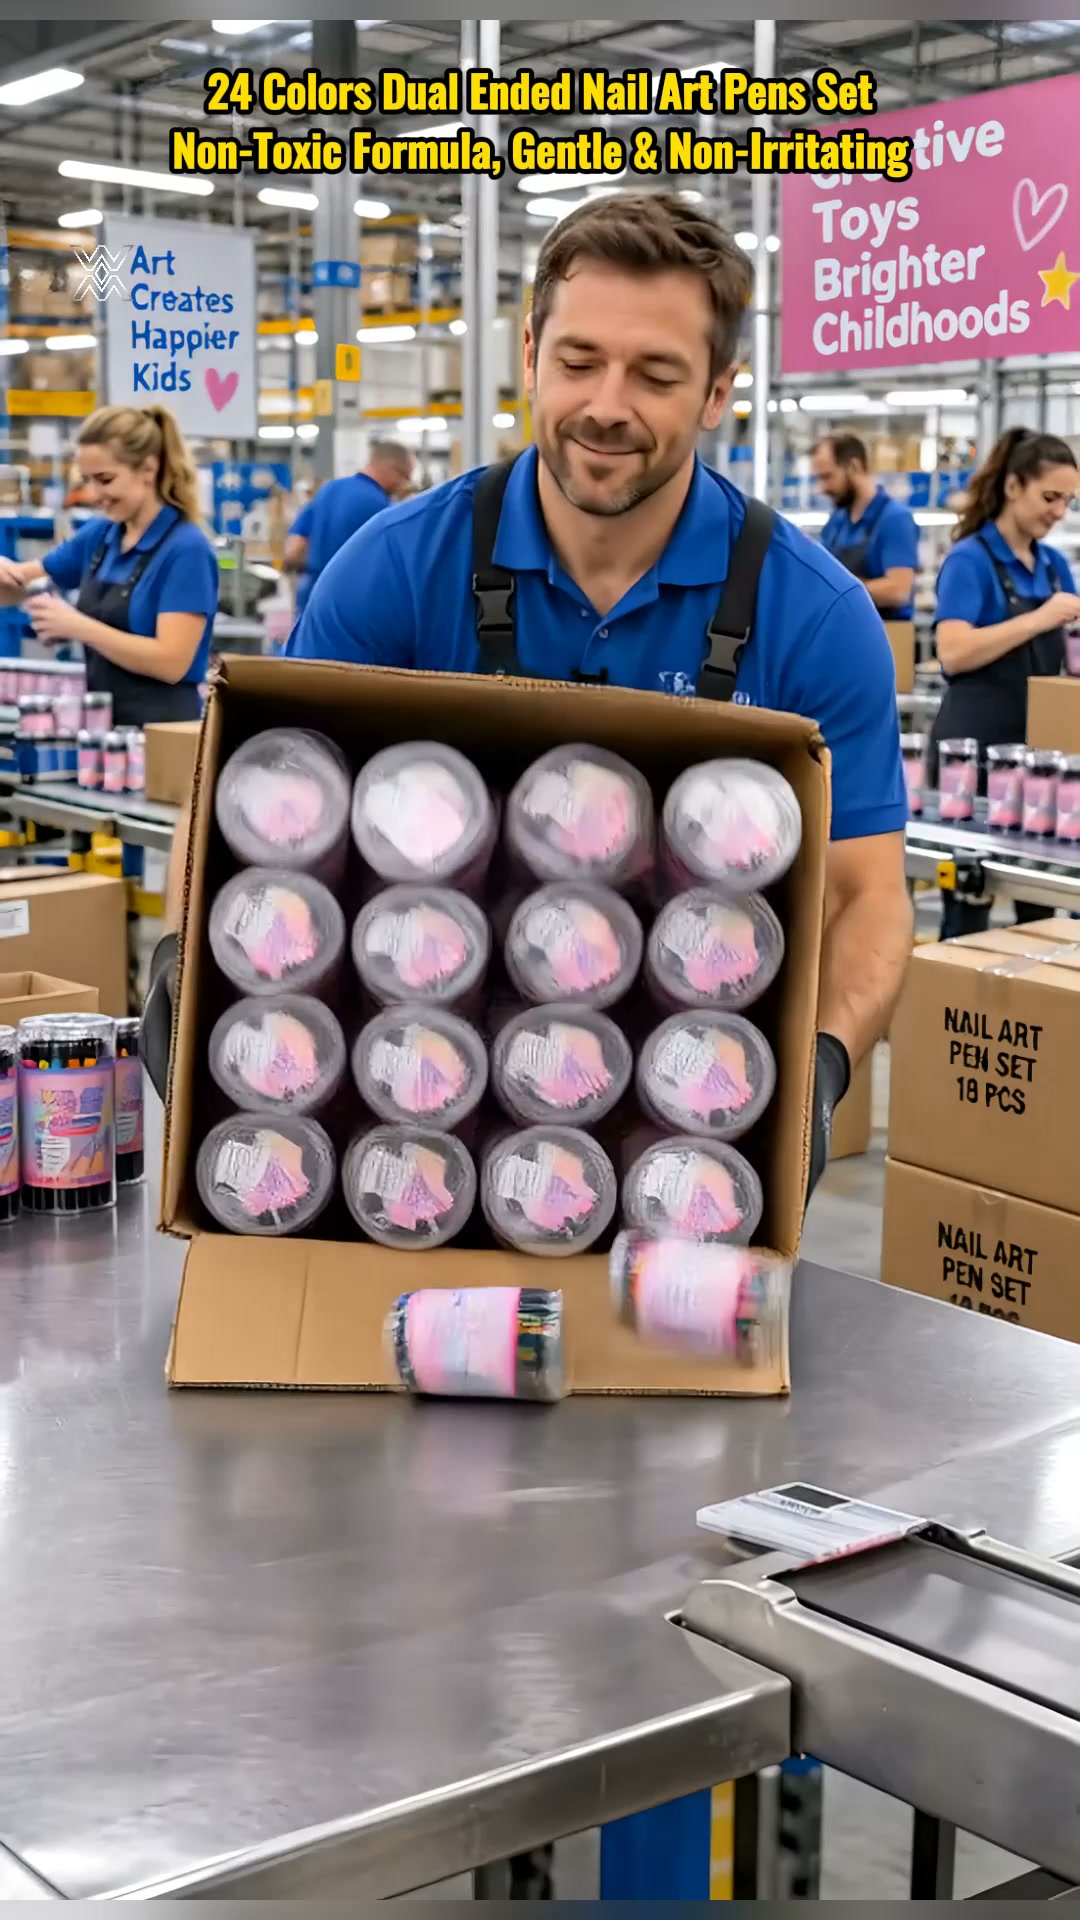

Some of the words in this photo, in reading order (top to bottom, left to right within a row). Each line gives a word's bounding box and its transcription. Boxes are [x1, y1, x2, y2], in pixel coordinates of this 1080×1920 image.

[811, 120, 1005, 189] tive
[812, 197, 920, 248] Toys
[129, 244, 177, 276] Art
[814, 244, 986, 304] Brighter
[130, 282, 235, 314] Creates
[131, 319, 241, 360] Happier
[812, 289, 1031, 356] Childhoods
[132, 360, 193, 393] Kids
[944, 1006, 994, 1041] NAIL
[997, 1018, 1043, 1052] ART
[949, 1040, 989, 1073] PEN
[994, 1051, 1037, 1082] SET
[956, 1076, 979, 1104] 18
[985, 1082, 1026, 1115] PCS
[937, 1220, 988, 1261] NAIL
[993, 1240, 1039, 1275] ART
[943, 1256, 983, 1292] PEN
[990, 1272, 1032, 1306] SET
